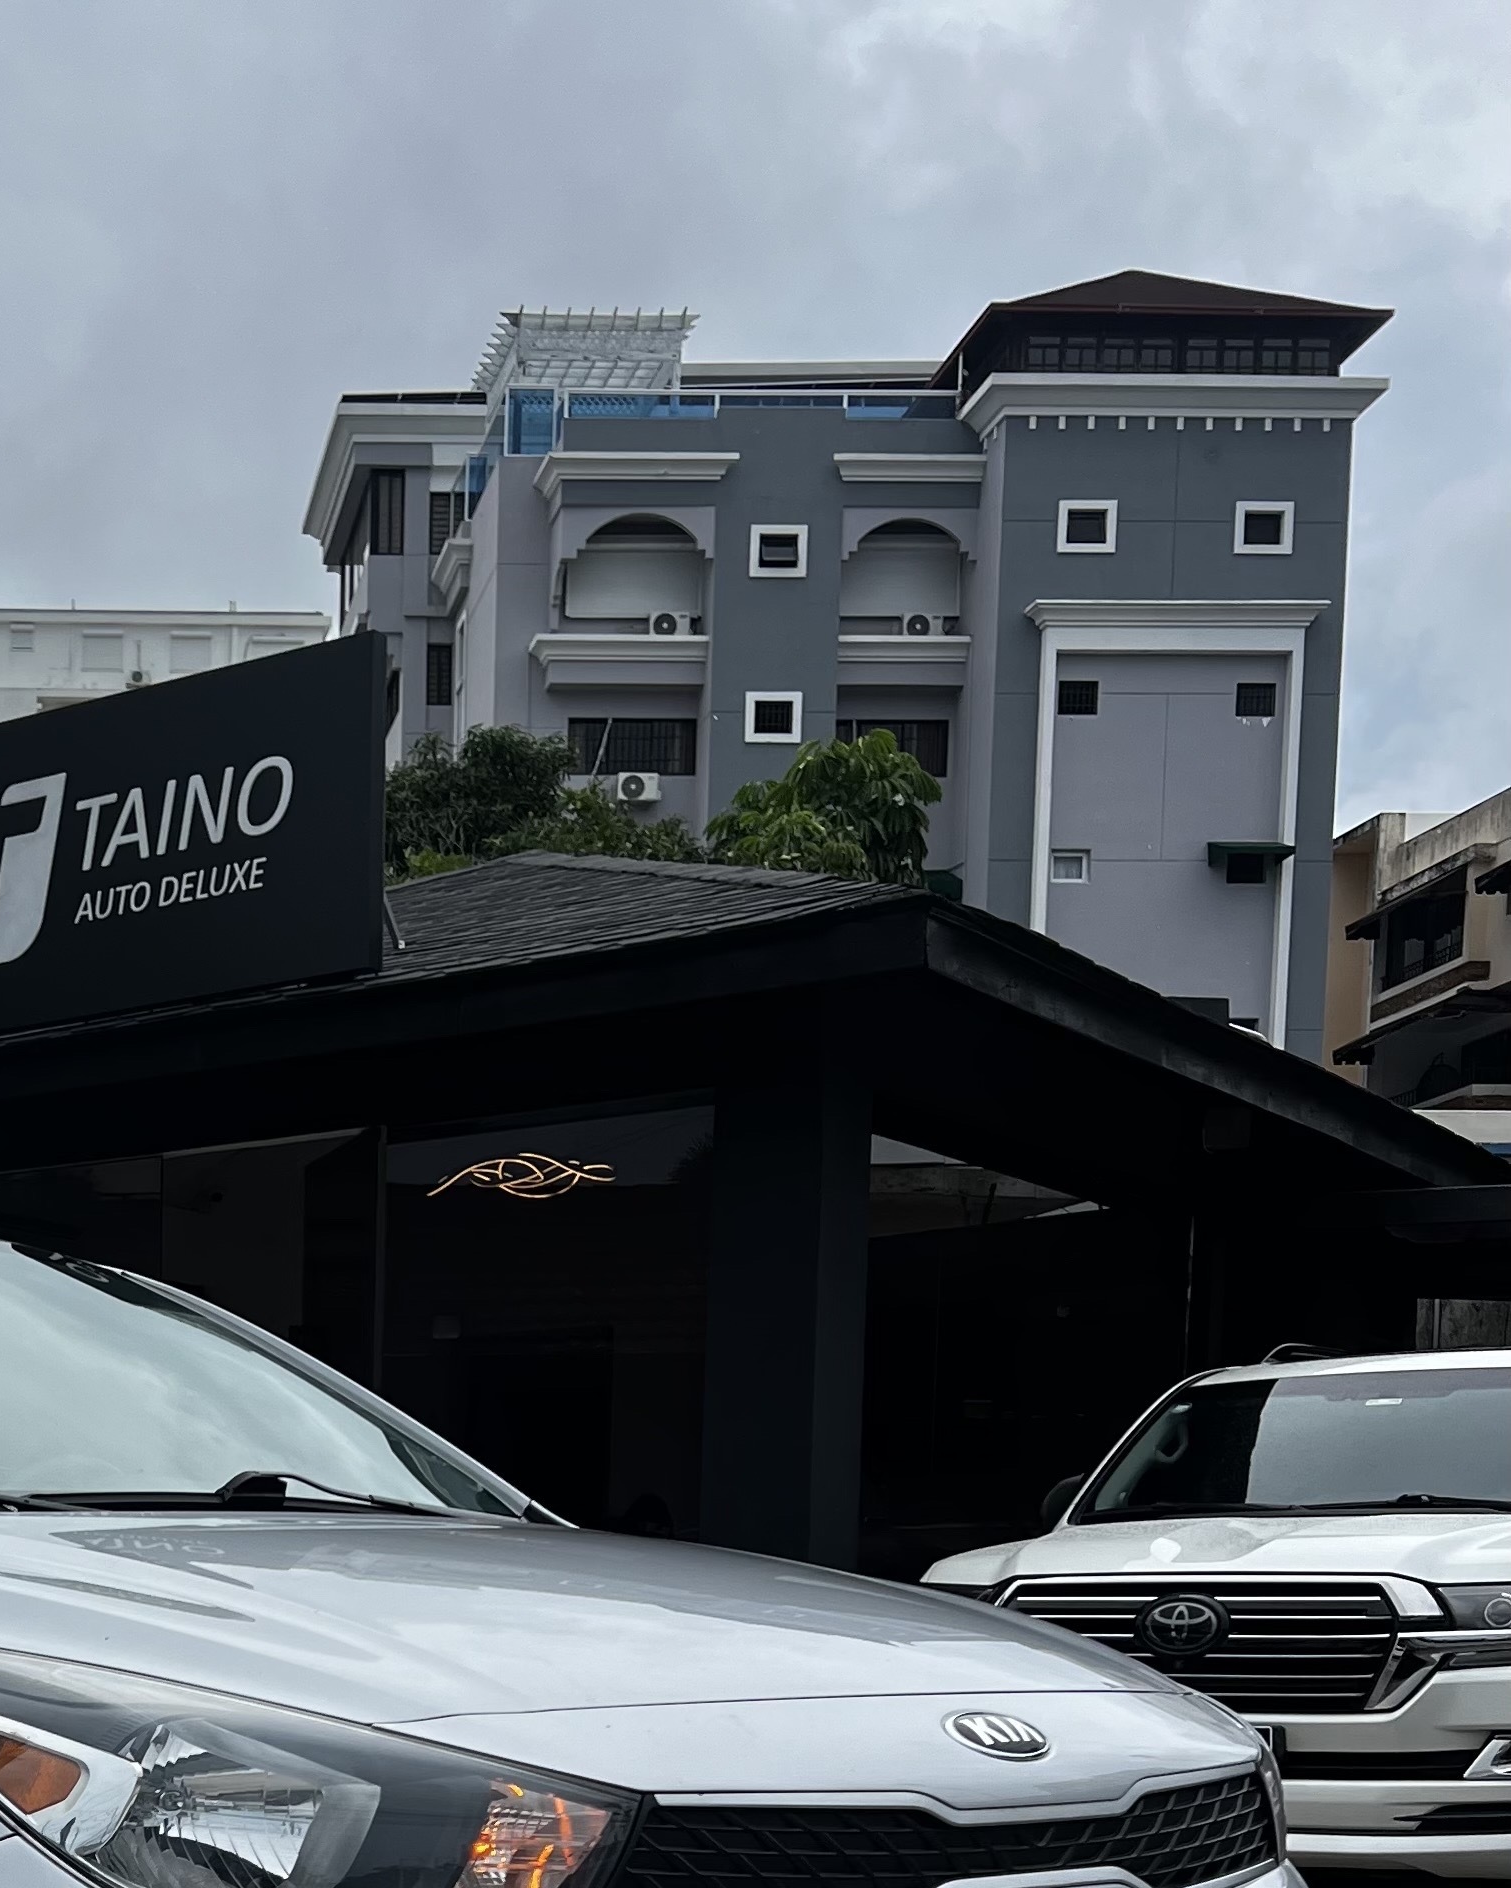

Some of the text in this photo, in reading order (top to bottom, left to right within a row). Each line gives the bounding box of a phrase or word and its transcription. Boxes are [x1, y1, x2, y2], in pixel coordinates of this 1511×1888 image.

[75, 755, 294, 871] TAINO
[74, 856, 267, 925] AUTO DELUXE
[958, 1715, 1045, 1746] KIA
